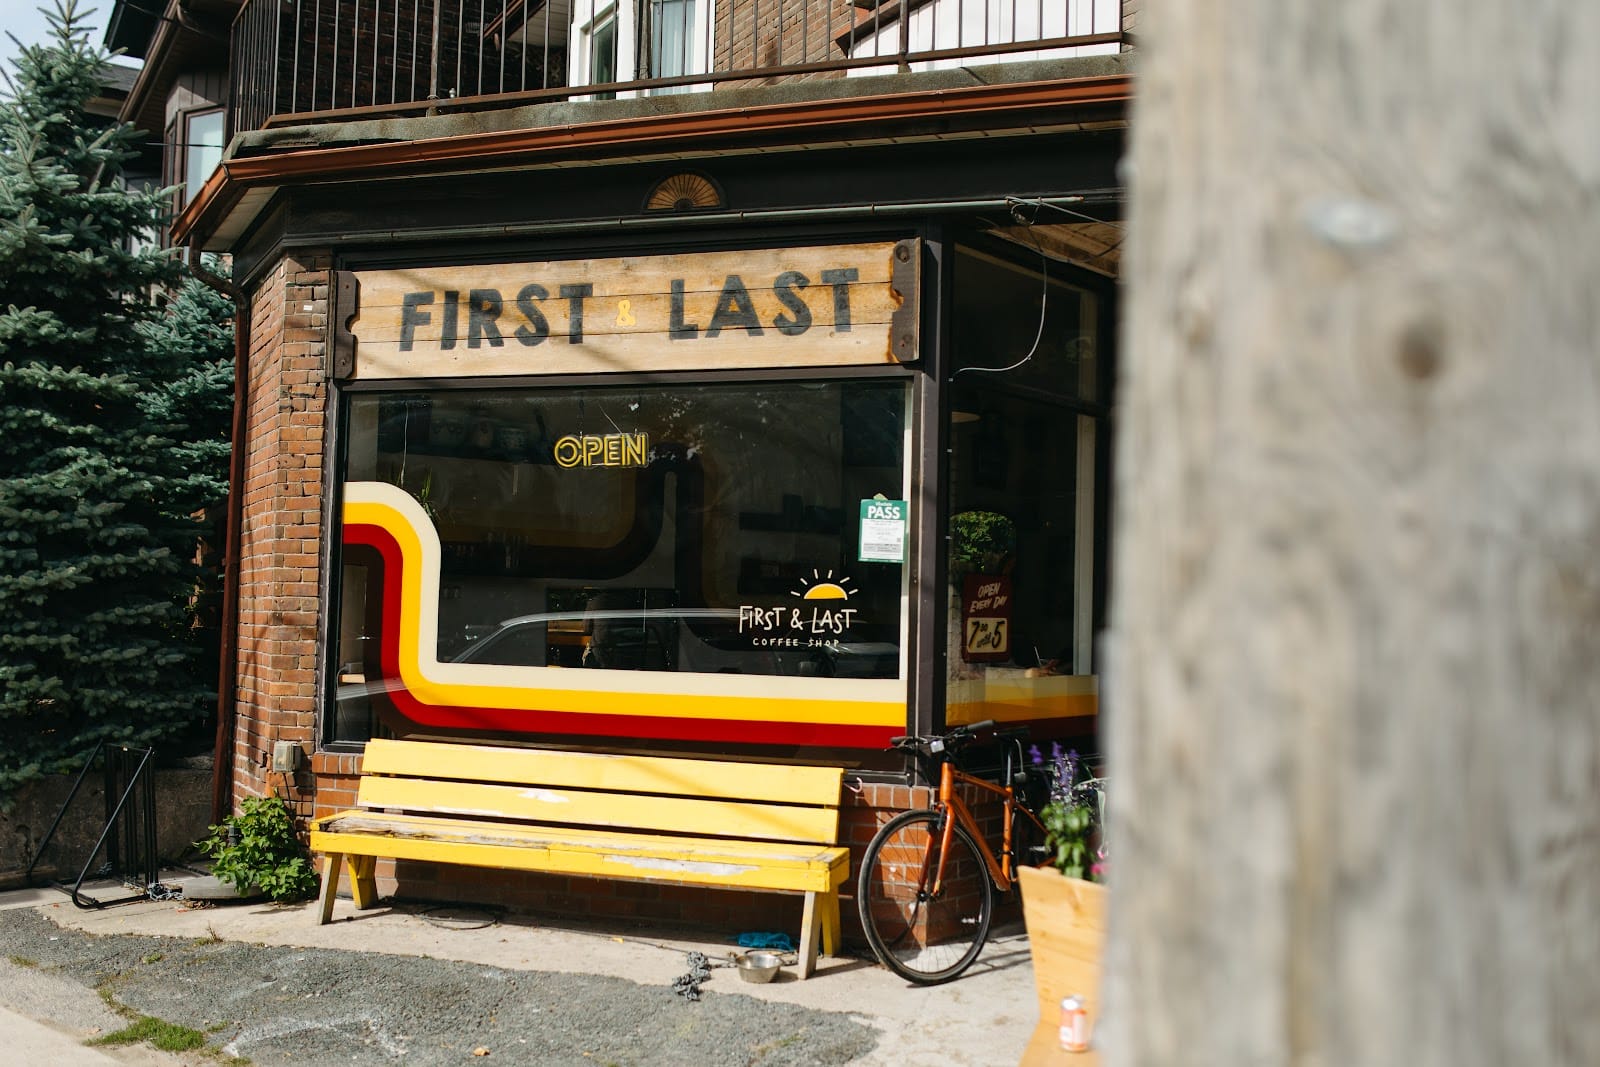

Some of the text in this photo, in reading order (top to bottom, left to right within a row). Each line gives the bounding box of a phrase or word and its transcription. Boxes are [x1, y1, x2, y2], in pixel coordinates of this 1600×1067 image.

[399, 267, 860, 352] FIRST & LAST
[554, 433, 647, 468] OPEN
[867, 506, 901, 519] PASS
[977, 582, 1001, 598] OPEN
[969, 595, 1008, 613] EVERY DAY
[739, 605, 858, 635] FIRST & LAST
[752, 637, 840, 648] COFFEE SHOP
